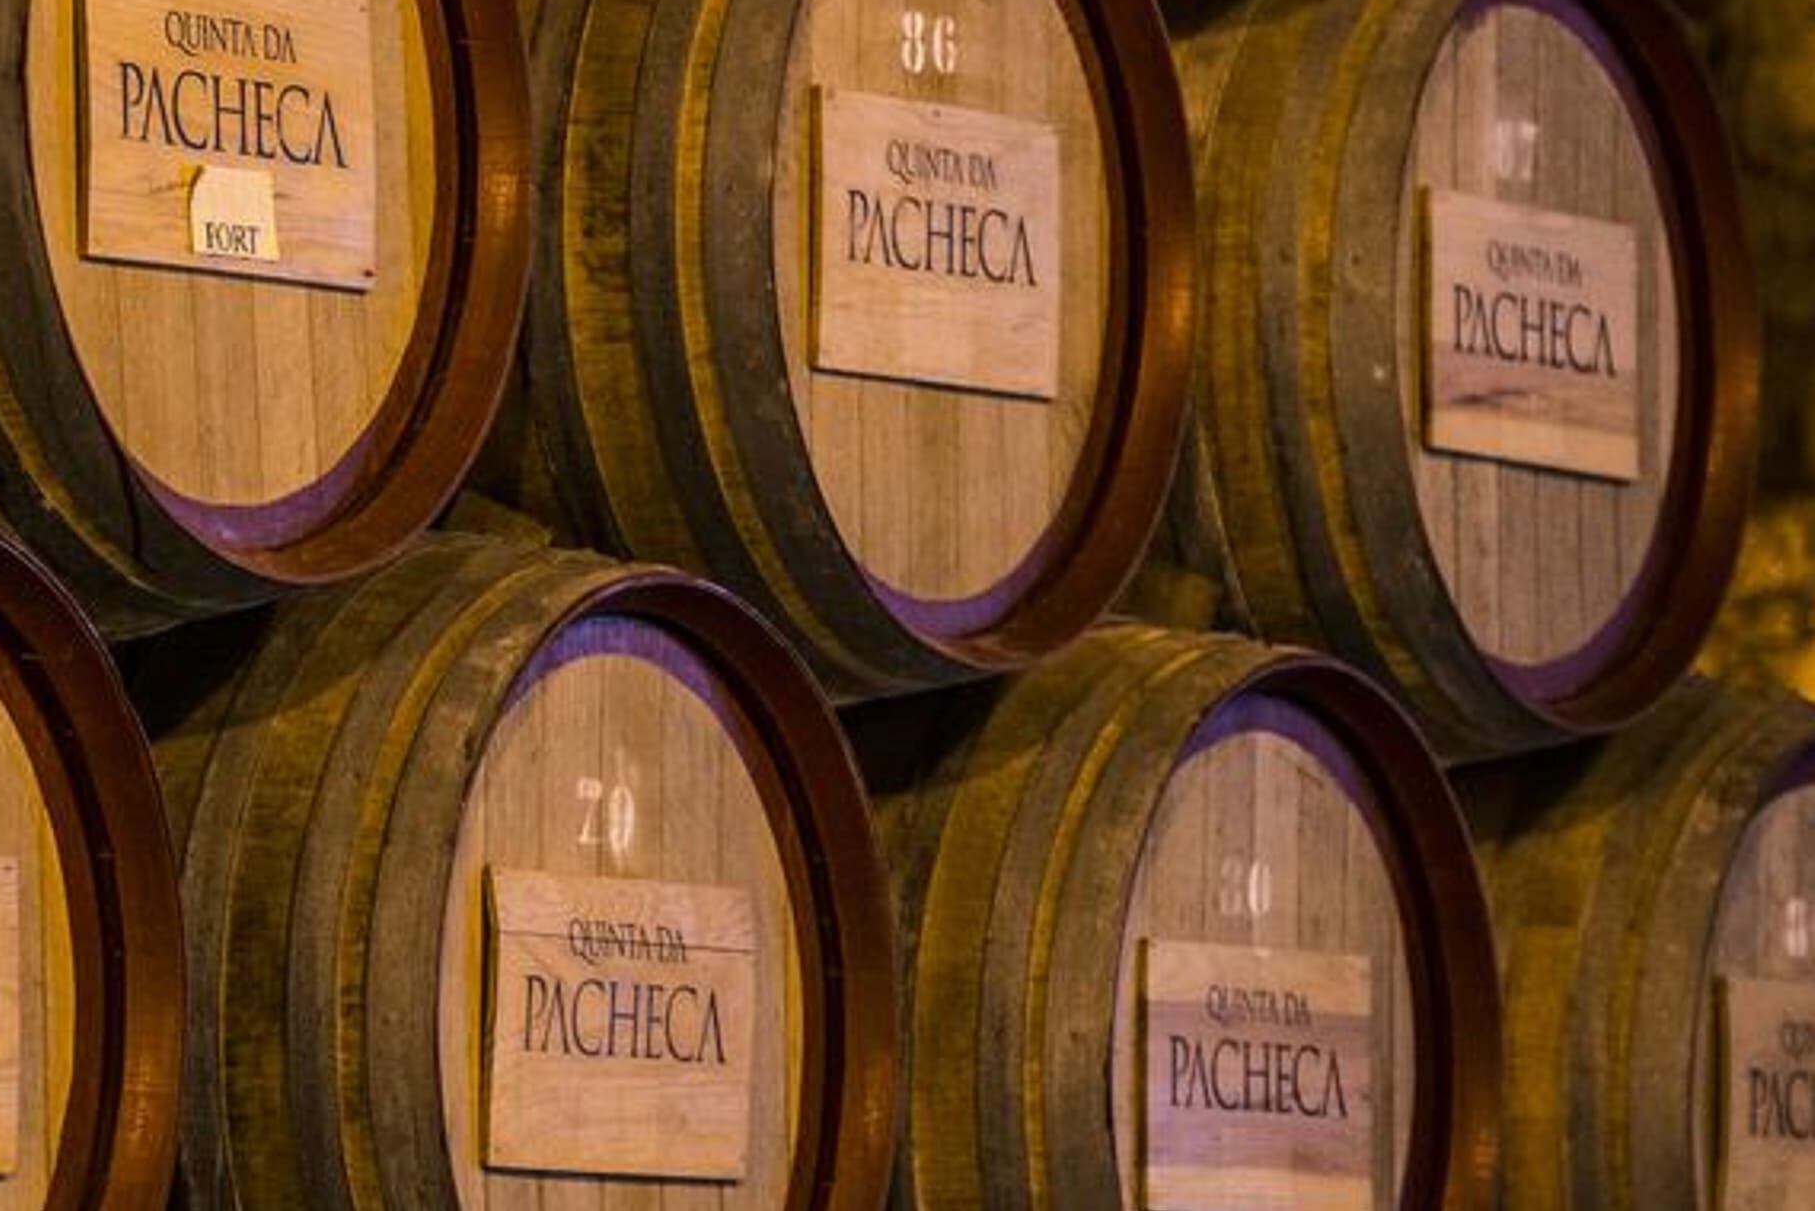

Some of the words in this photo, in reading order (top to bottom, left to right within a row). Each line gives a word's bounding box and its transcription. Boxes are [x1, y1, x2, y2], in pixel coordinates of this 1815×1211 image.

[164, 9, 257, 58] QUINTA
[263, 23, 297, 64] DA
[900, 10, 958, 75] 86
[119, 61, 349, 169] PACHECA
[886, 138, 963, 186] QUINTA
[969, 153, 999, 190] DA
[847, 188, 1037, 287] PACHECA
[1453, 282, 1617, 379] PACHECA
[568, 917, 651, 964] QUINTA
[657, 926, 688, 965] DA
[523, 974, 726, 1064] PACHECA
[1168, 1035, 1348, 1120] PACHECA
